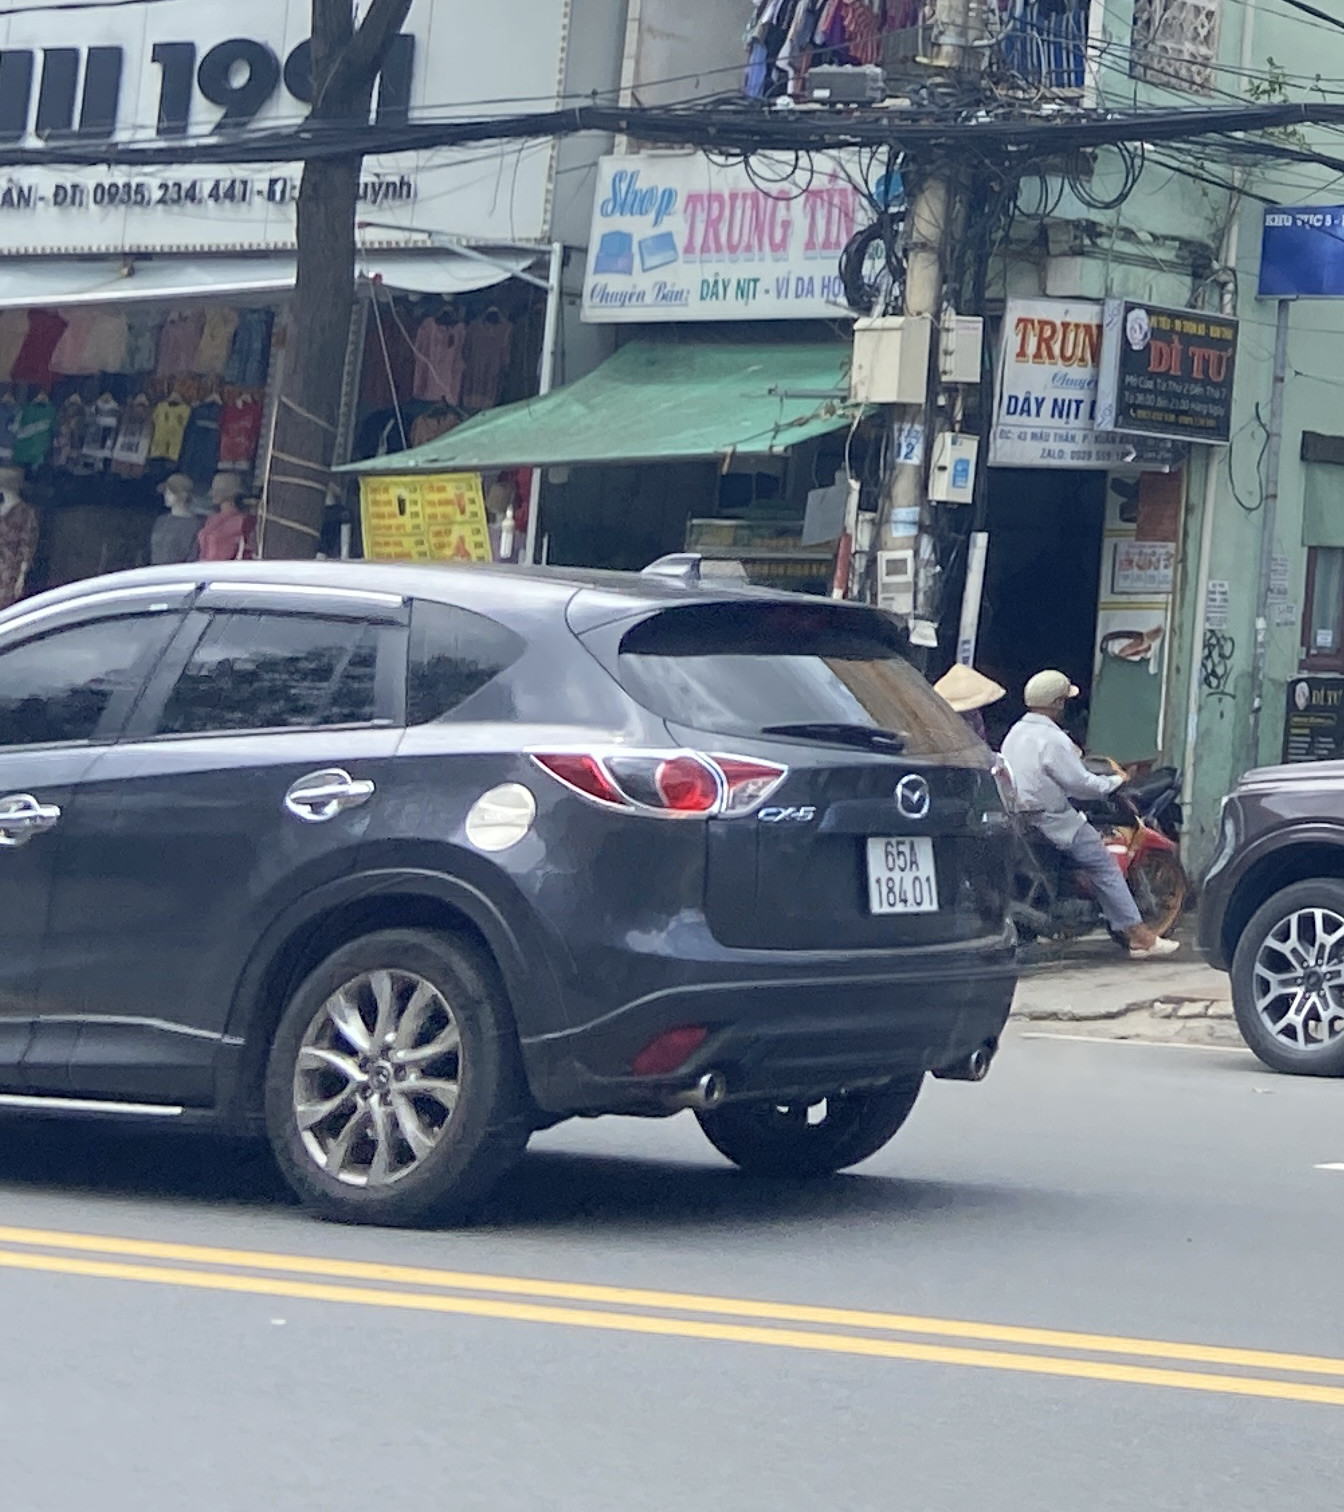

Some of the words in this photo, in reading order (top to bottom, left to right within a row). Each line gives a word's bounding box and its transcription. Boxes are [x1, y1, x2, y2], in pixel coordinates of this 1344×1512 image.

[600, 169, 679, 228] Shop
[682, 189, 796, 258] TRUNG
[700, 272, 731, 301] DÂY
[735, 276, 761, 307] NỊT
[775, 269, 794, 300] VÍ
[795, 275, 815, 299] DA
[1188, 345, 1233, 383] TƯ
[1006, 390, 1047, 419] DÂY
[1050, 397, 1086, 426] NỊT
[757, 805, 818, 823] CX-5
[883, 839, 921, 873] 65A
[874, 874, 935, 911] 184.01
